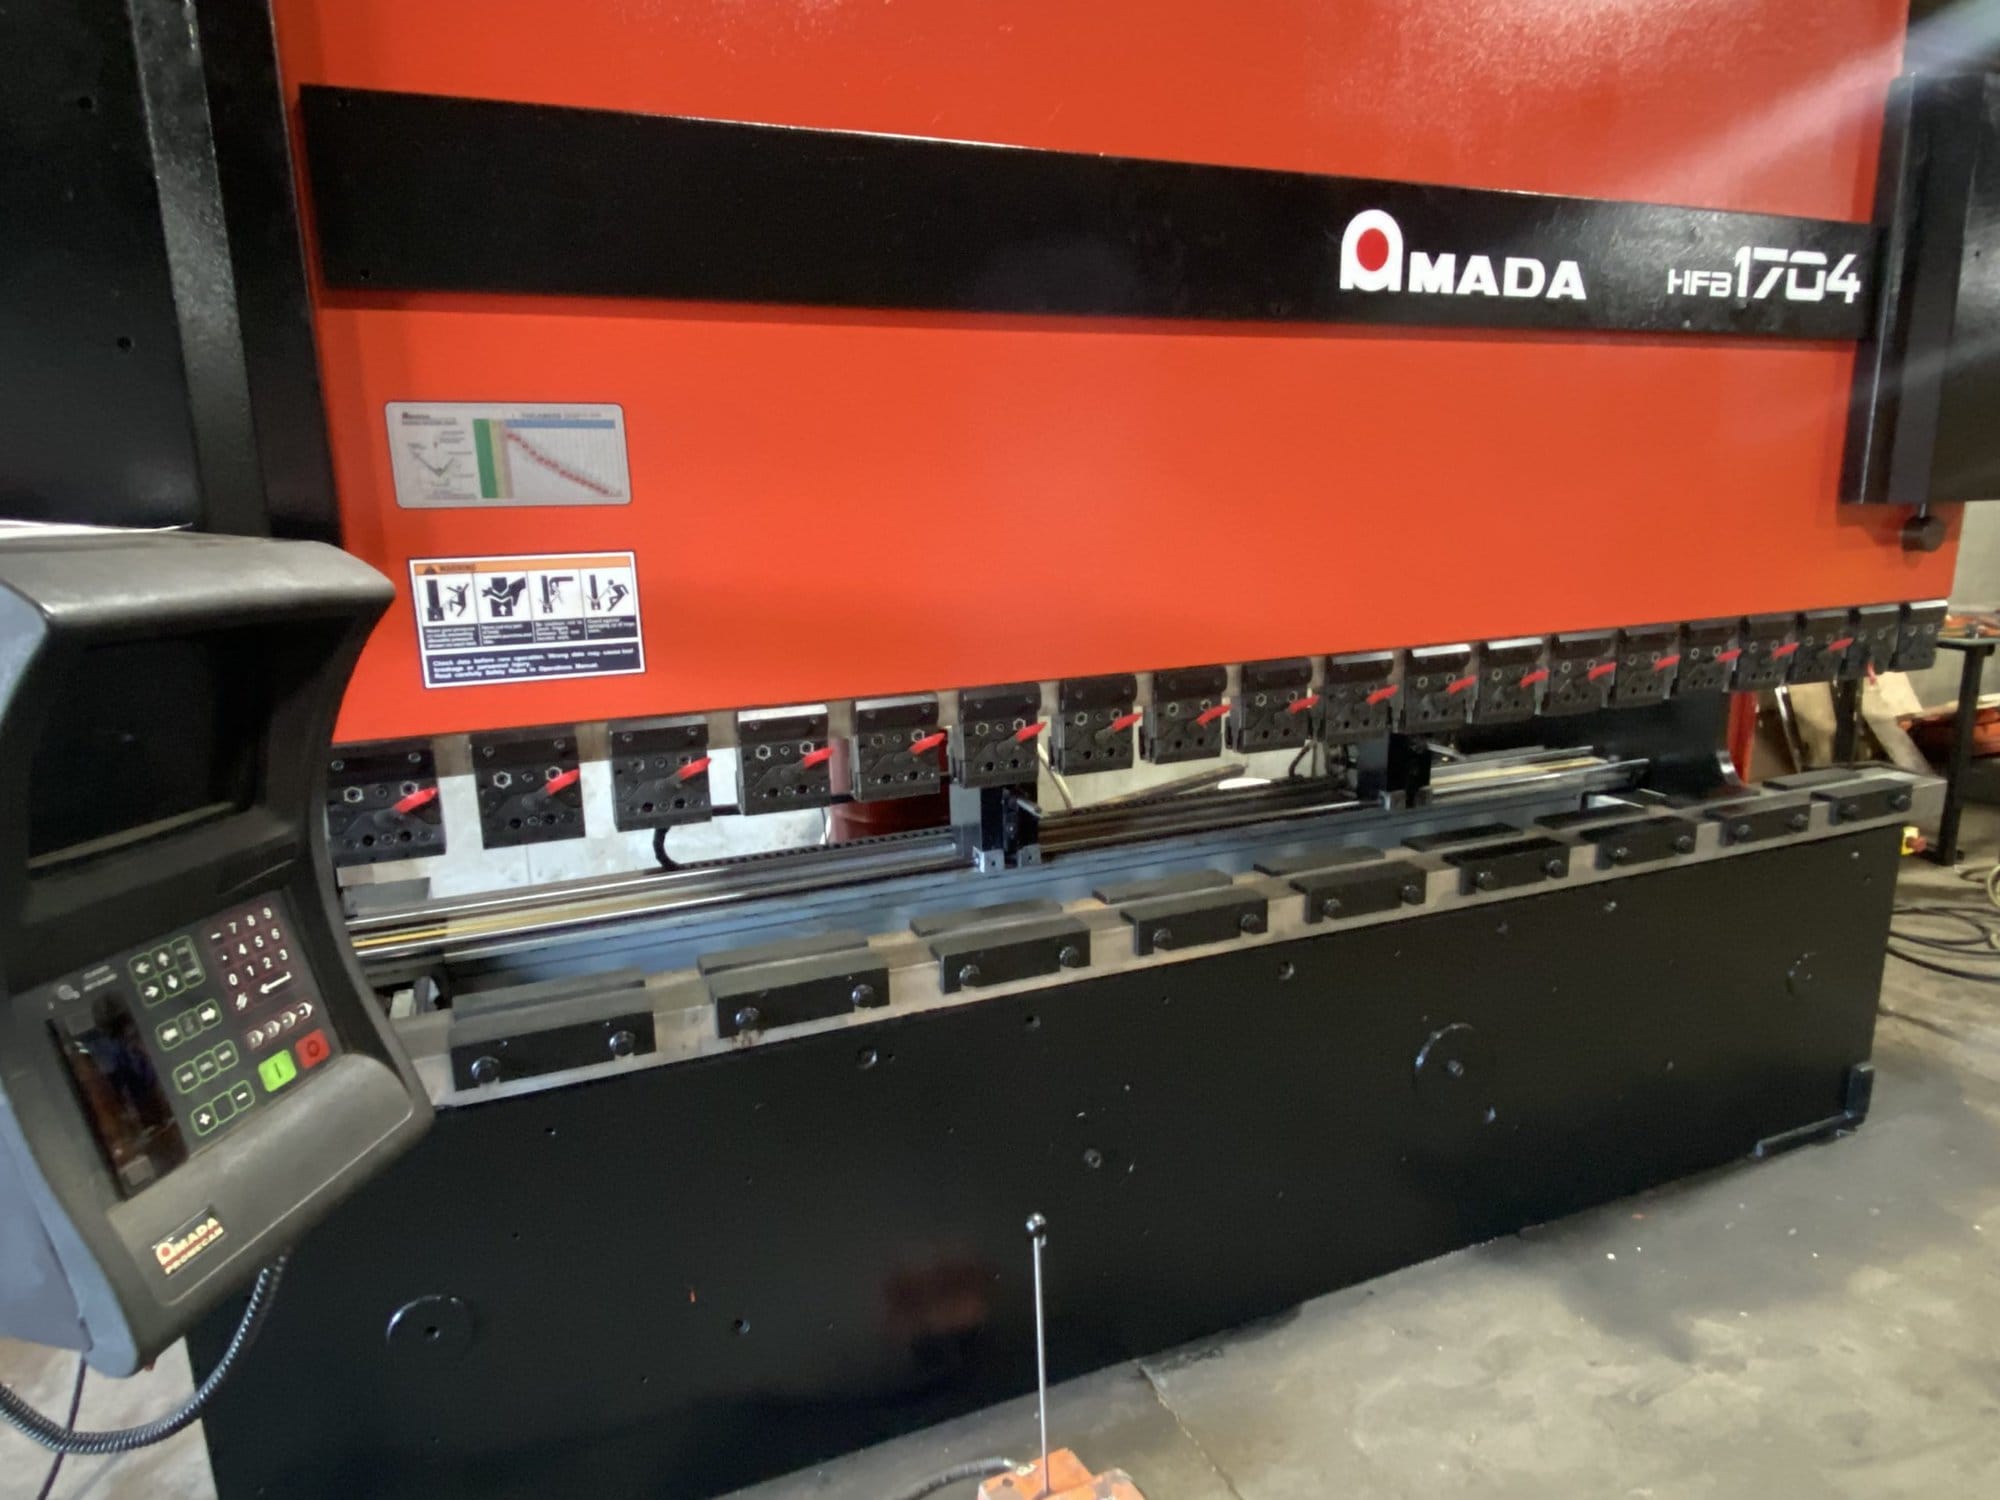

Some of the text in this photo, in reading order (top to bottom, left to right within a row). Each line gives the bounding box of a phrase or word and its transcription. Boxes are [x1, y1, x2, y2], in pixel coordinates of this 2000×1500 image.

[1340, 209, 1587, 301] AMADA
[228, 907, 272, 934] 7 8 9
[239, 928, 280, 955] 4 5 6
[247, 965, 255, 976] 1
[263, 957, 272, 969] 2
[279, 949, 288, 960] 3
